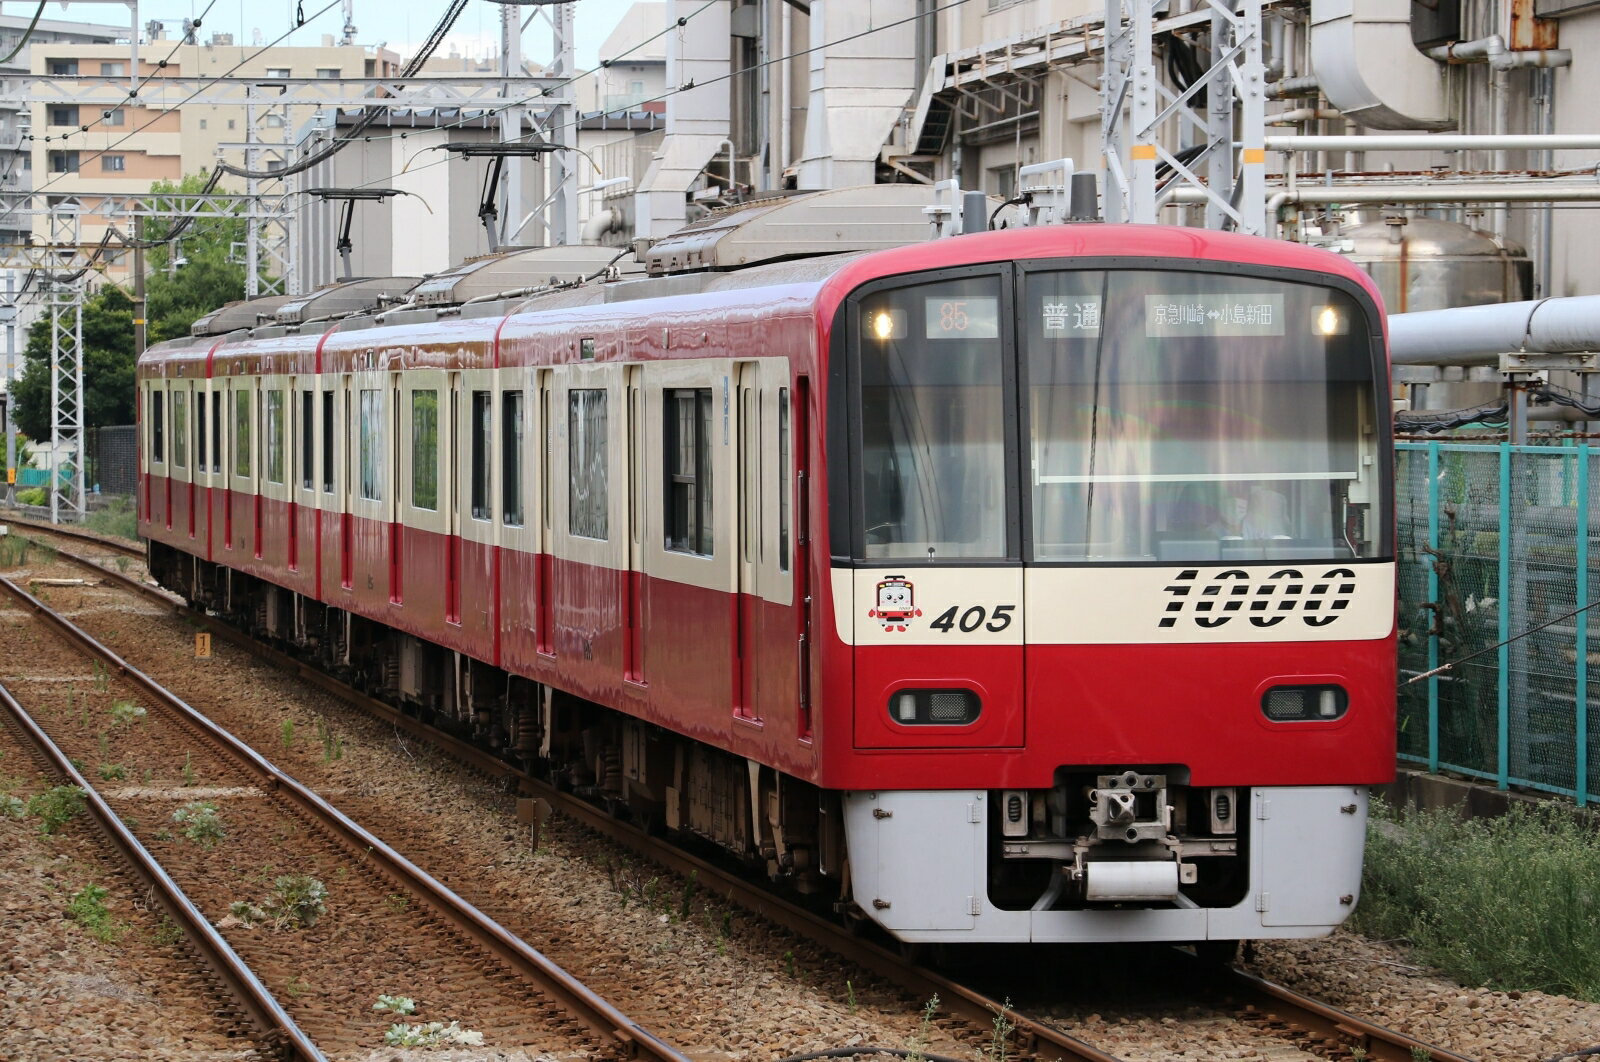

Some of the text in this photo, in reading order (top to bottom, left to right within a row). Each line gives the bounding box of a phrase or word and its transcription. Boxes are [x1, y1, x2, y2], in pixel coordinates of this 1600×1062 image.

[940, 301, 968, 331] 85
[1042, 302, 1100, 330] 普通
[1153, 303, 1273, 325] 京急川崎 小島新田
[1157, 567, 1356, 628] 1000
[929, 604, 1016, 633] 405
[199, 634, 206, 648] 1
